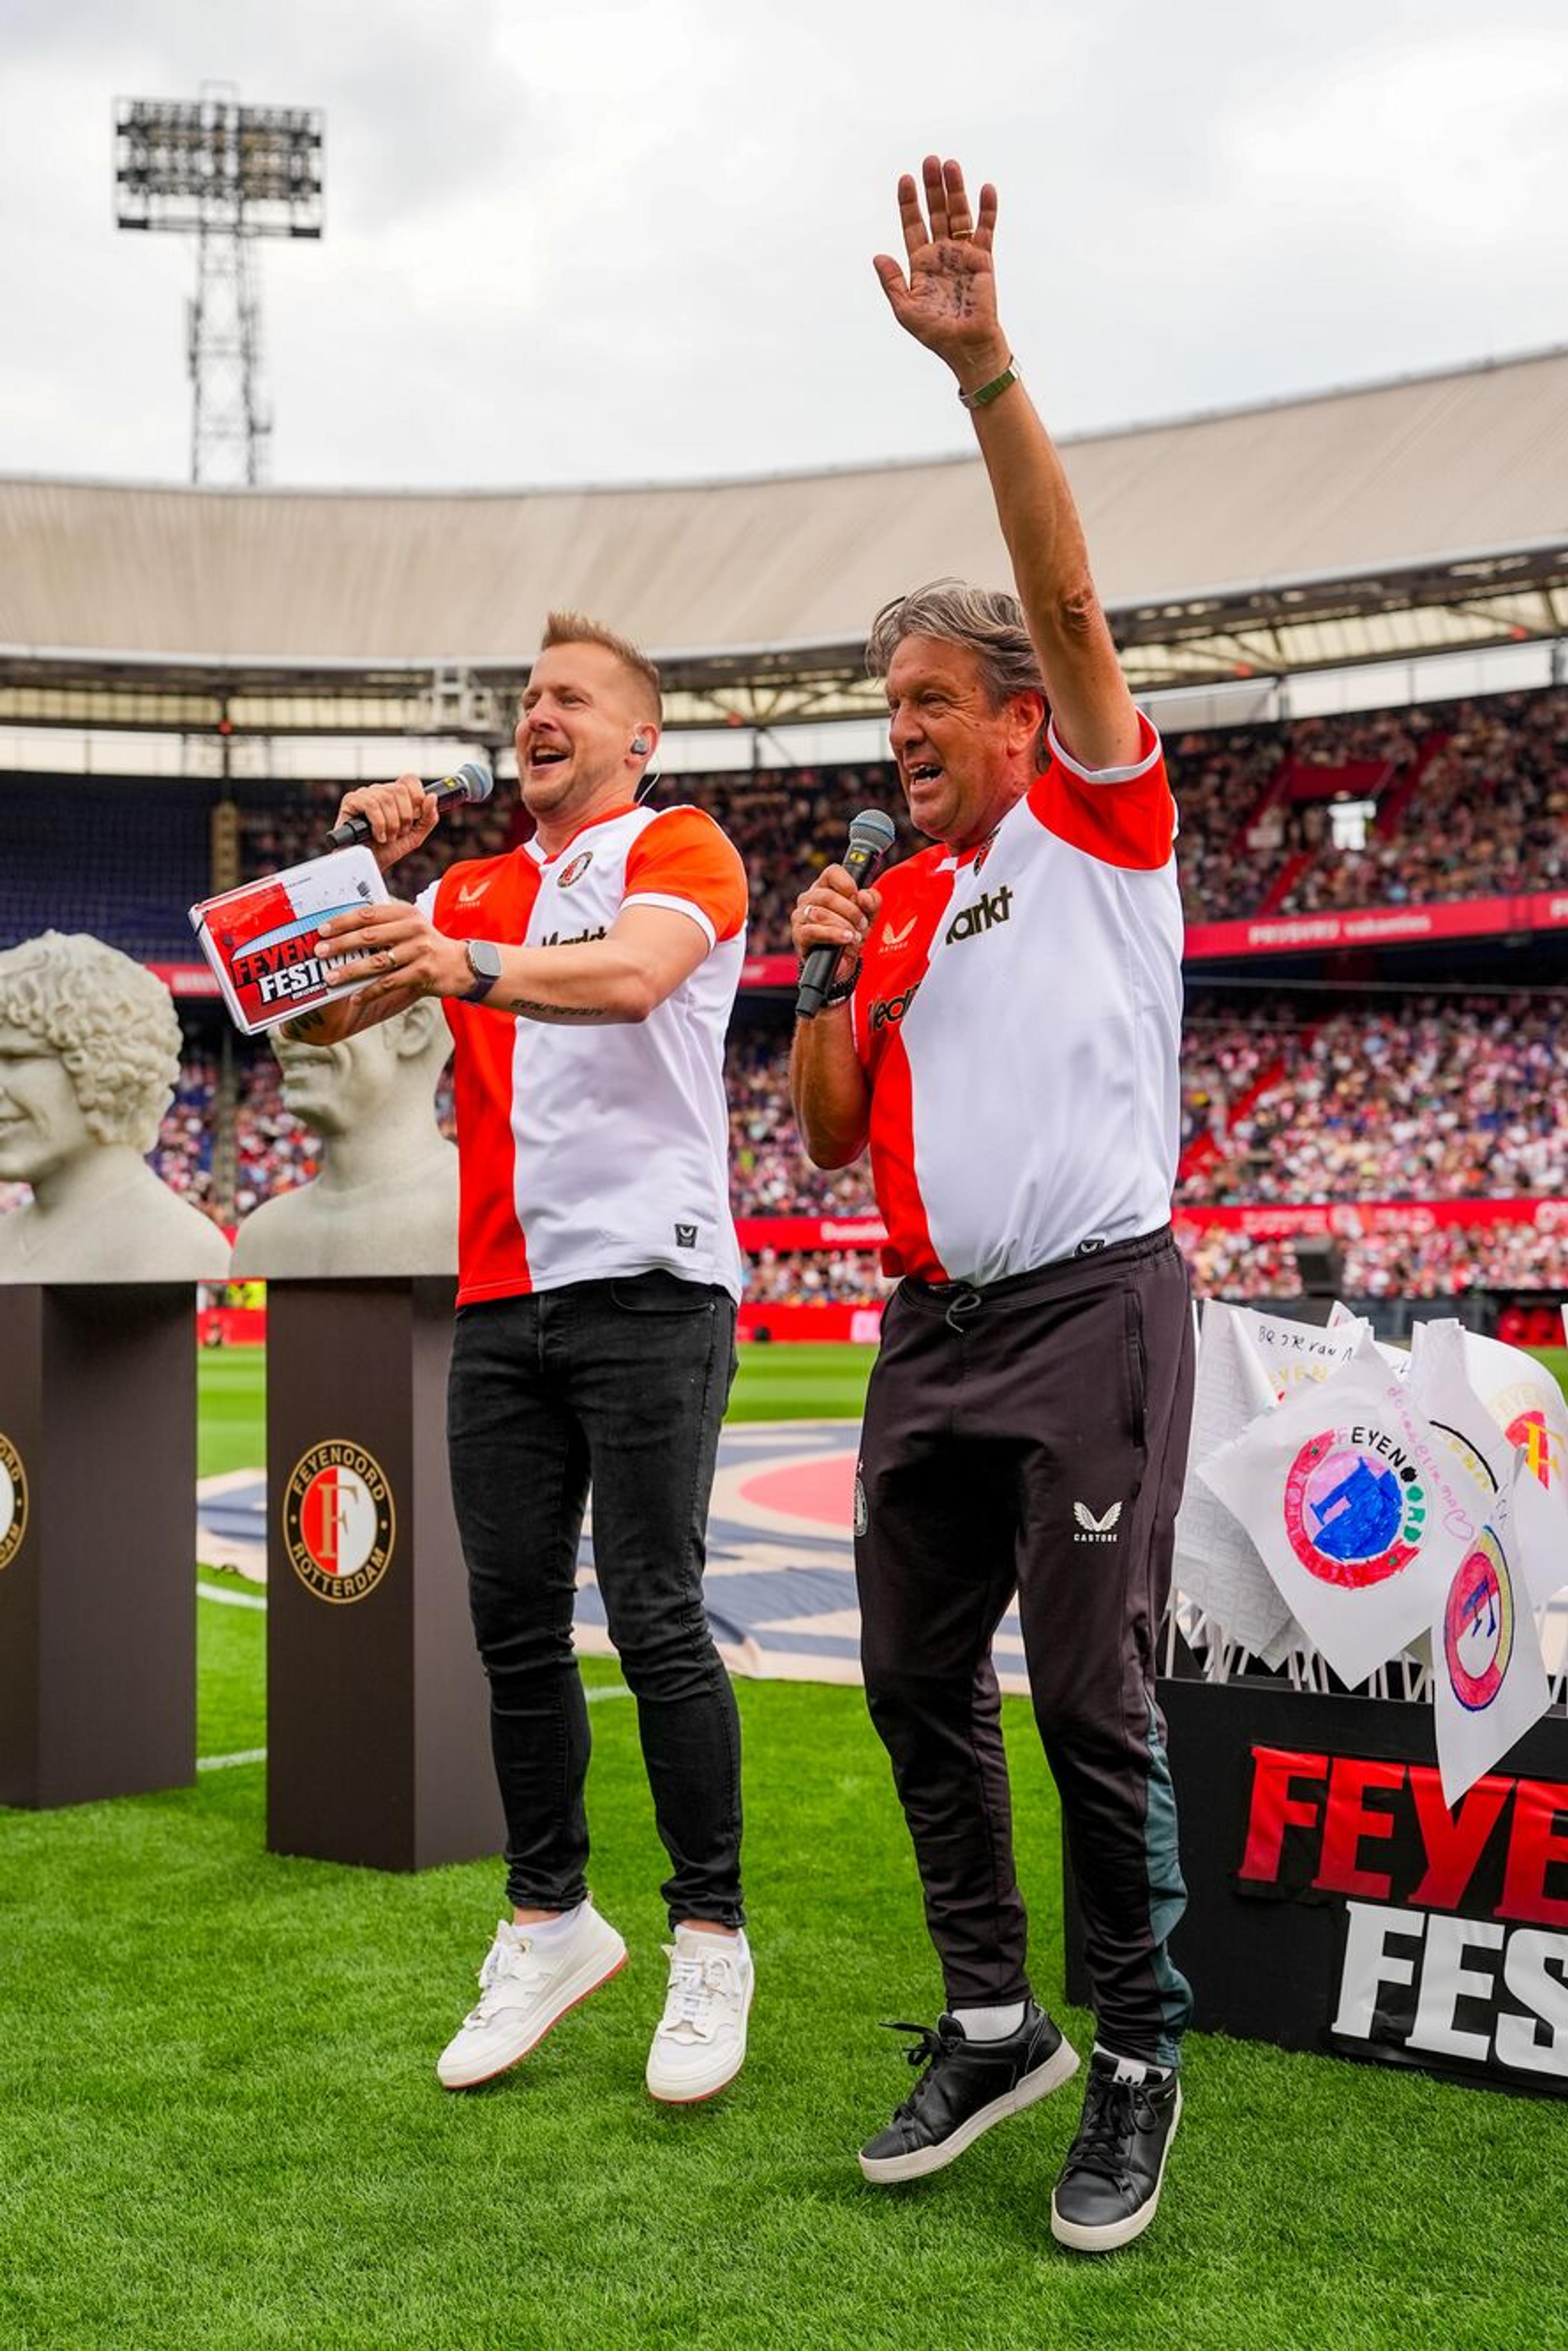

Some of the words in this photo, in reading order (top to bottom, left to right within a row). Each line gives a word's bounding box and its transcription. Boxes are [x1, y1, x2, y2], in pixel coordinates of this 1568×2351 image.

[946, 885, 1013, 946] arkt
[292, 1446, 386, 1502] FEYENOORD
[292, 1542, 386, 1597] ROTTERDAM
[1237, 1745, 1568, 1929] FEYE
[1330, 1900, 1568, 2078] FES
